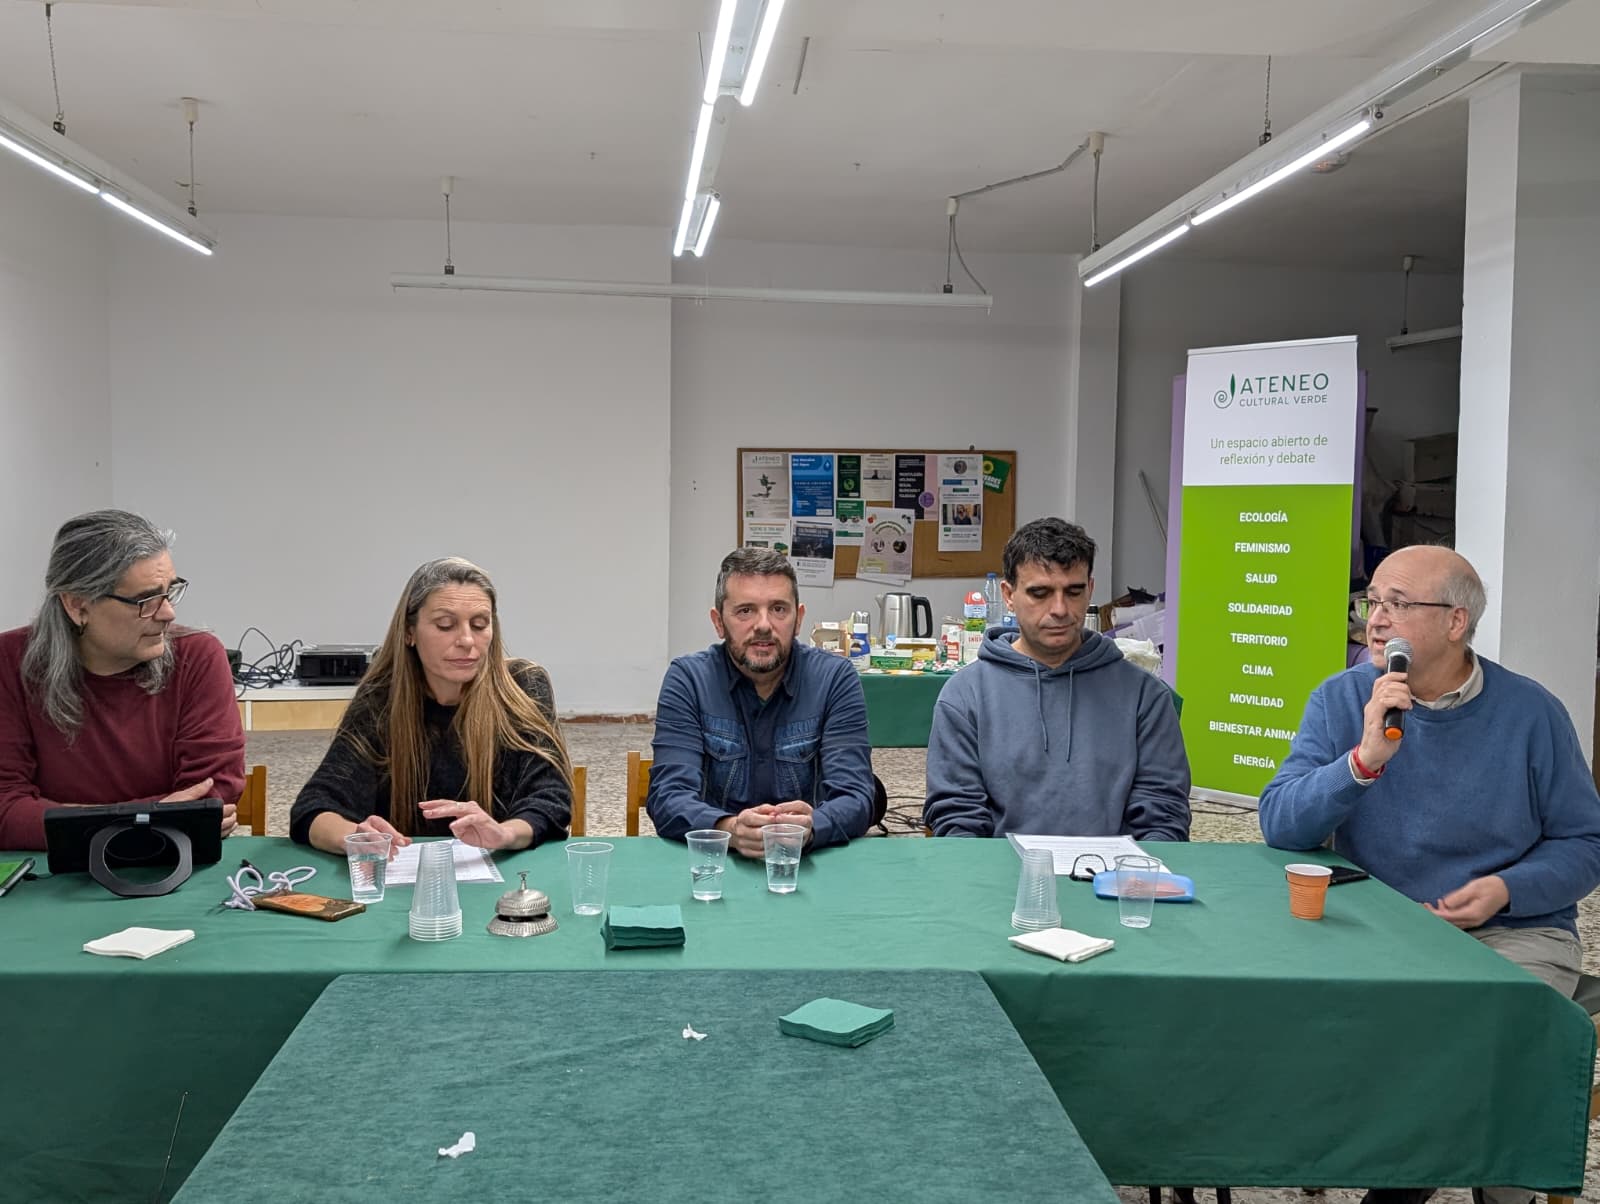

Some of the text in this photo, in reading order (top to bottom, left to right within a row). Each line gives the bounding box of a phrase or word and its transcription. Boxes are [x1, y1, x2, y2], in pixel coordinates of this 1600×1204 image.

[1240, 373, 1329, 395] ATENEO
[1239, 394, 1328, 407] CULTURAL VERDE
[1210, 434, 1329, 451] Un espacio abierto de
[1220, 452, 1316, 467] reflexión y debate
[1239, 510, 1288, 523] ECOLOGÍA
[1234, 542, 1290, 554] FEMINISMO
[1245, 573, 1278, 585] SALUD
[1228, 602, 1293, 616] SOLIDARIDAD
[1231, 633, 1288, 647] TERRITORIO
[1242, 664, 1274, 677] CLIMA
[1229, 693, 1284, 708] MOVILIDAD
[1209, 720, 1297, 741] BIENESTAR ANIMA
[1233, 754, 1276, 769] ENERGÍA
